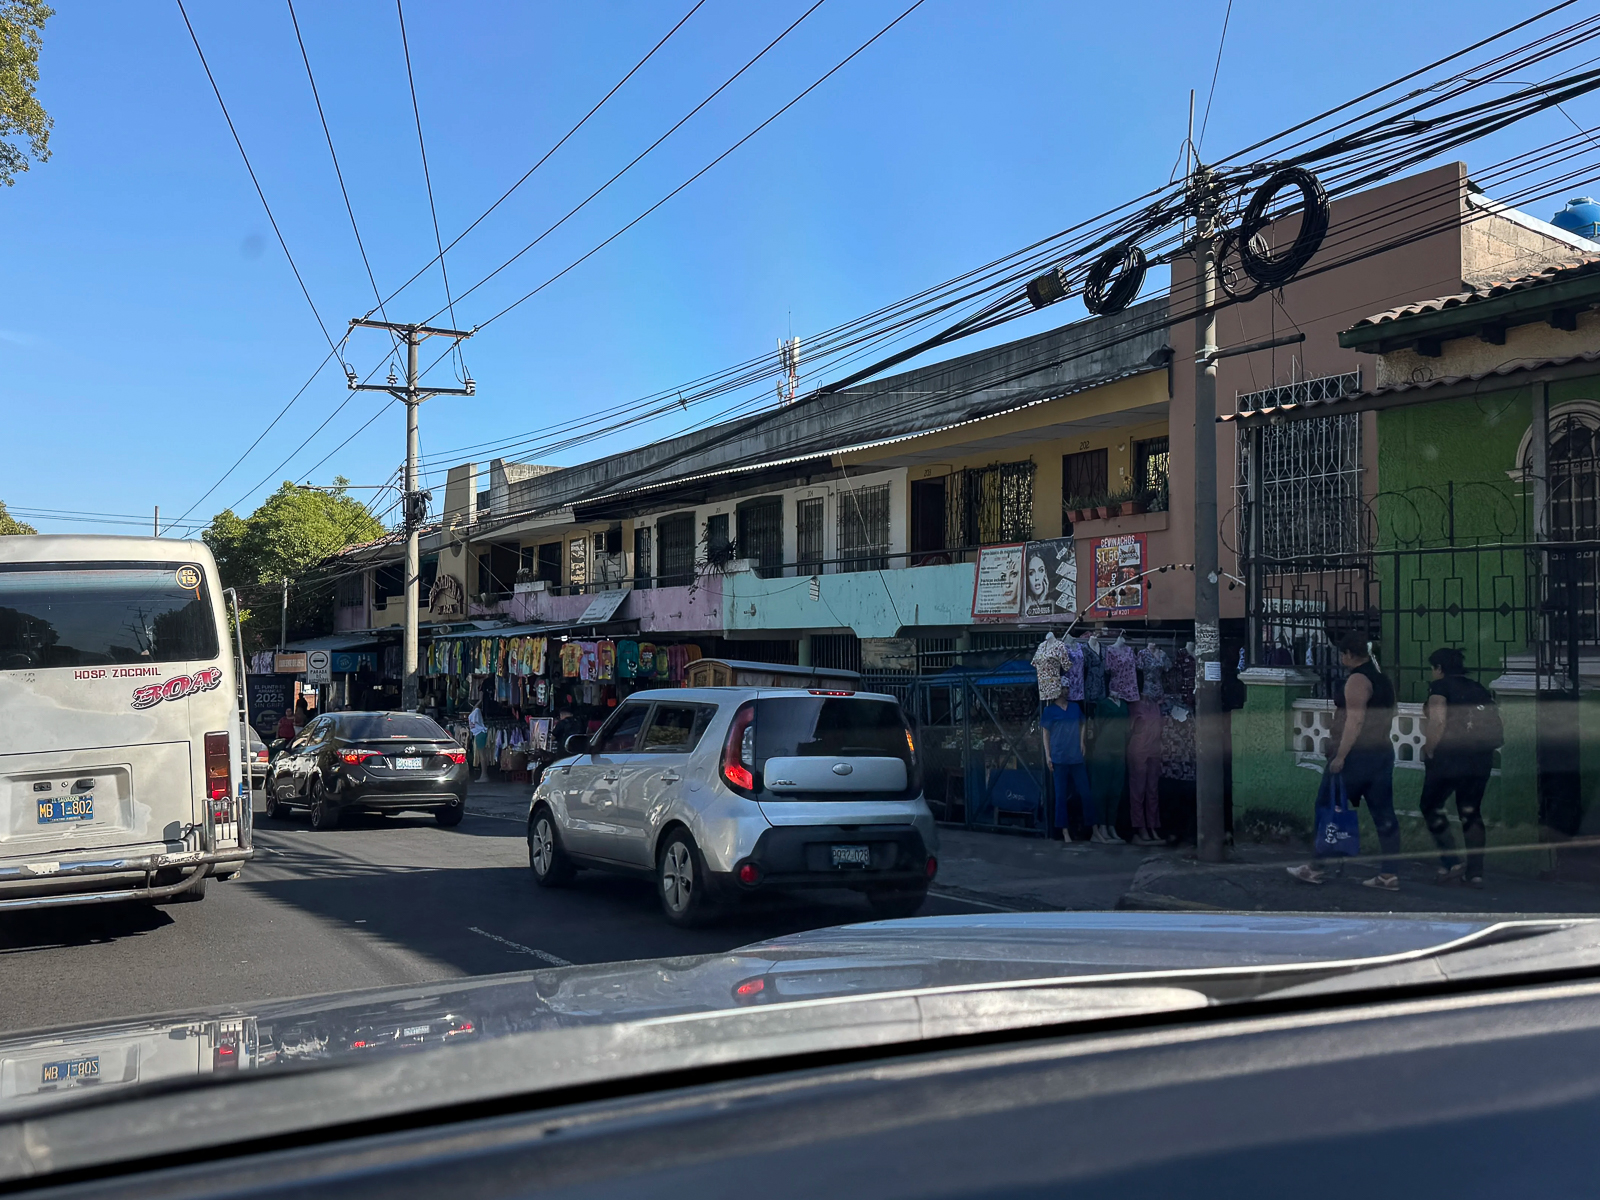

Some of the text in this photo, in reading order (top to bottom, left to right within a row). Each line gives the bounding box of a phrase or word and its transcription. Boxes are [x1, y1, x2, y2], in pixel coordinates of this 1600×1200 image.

[1079, 440, 1090, 451] 202
[1096, 550, 1119, 564] $1.50
[181, 575, 198, 584] 19
[74, 667, 162, 680] HOSP. ZACAMIL
[255, 693, 285, 703] 2025
[39, 803, 54, 818] MB
